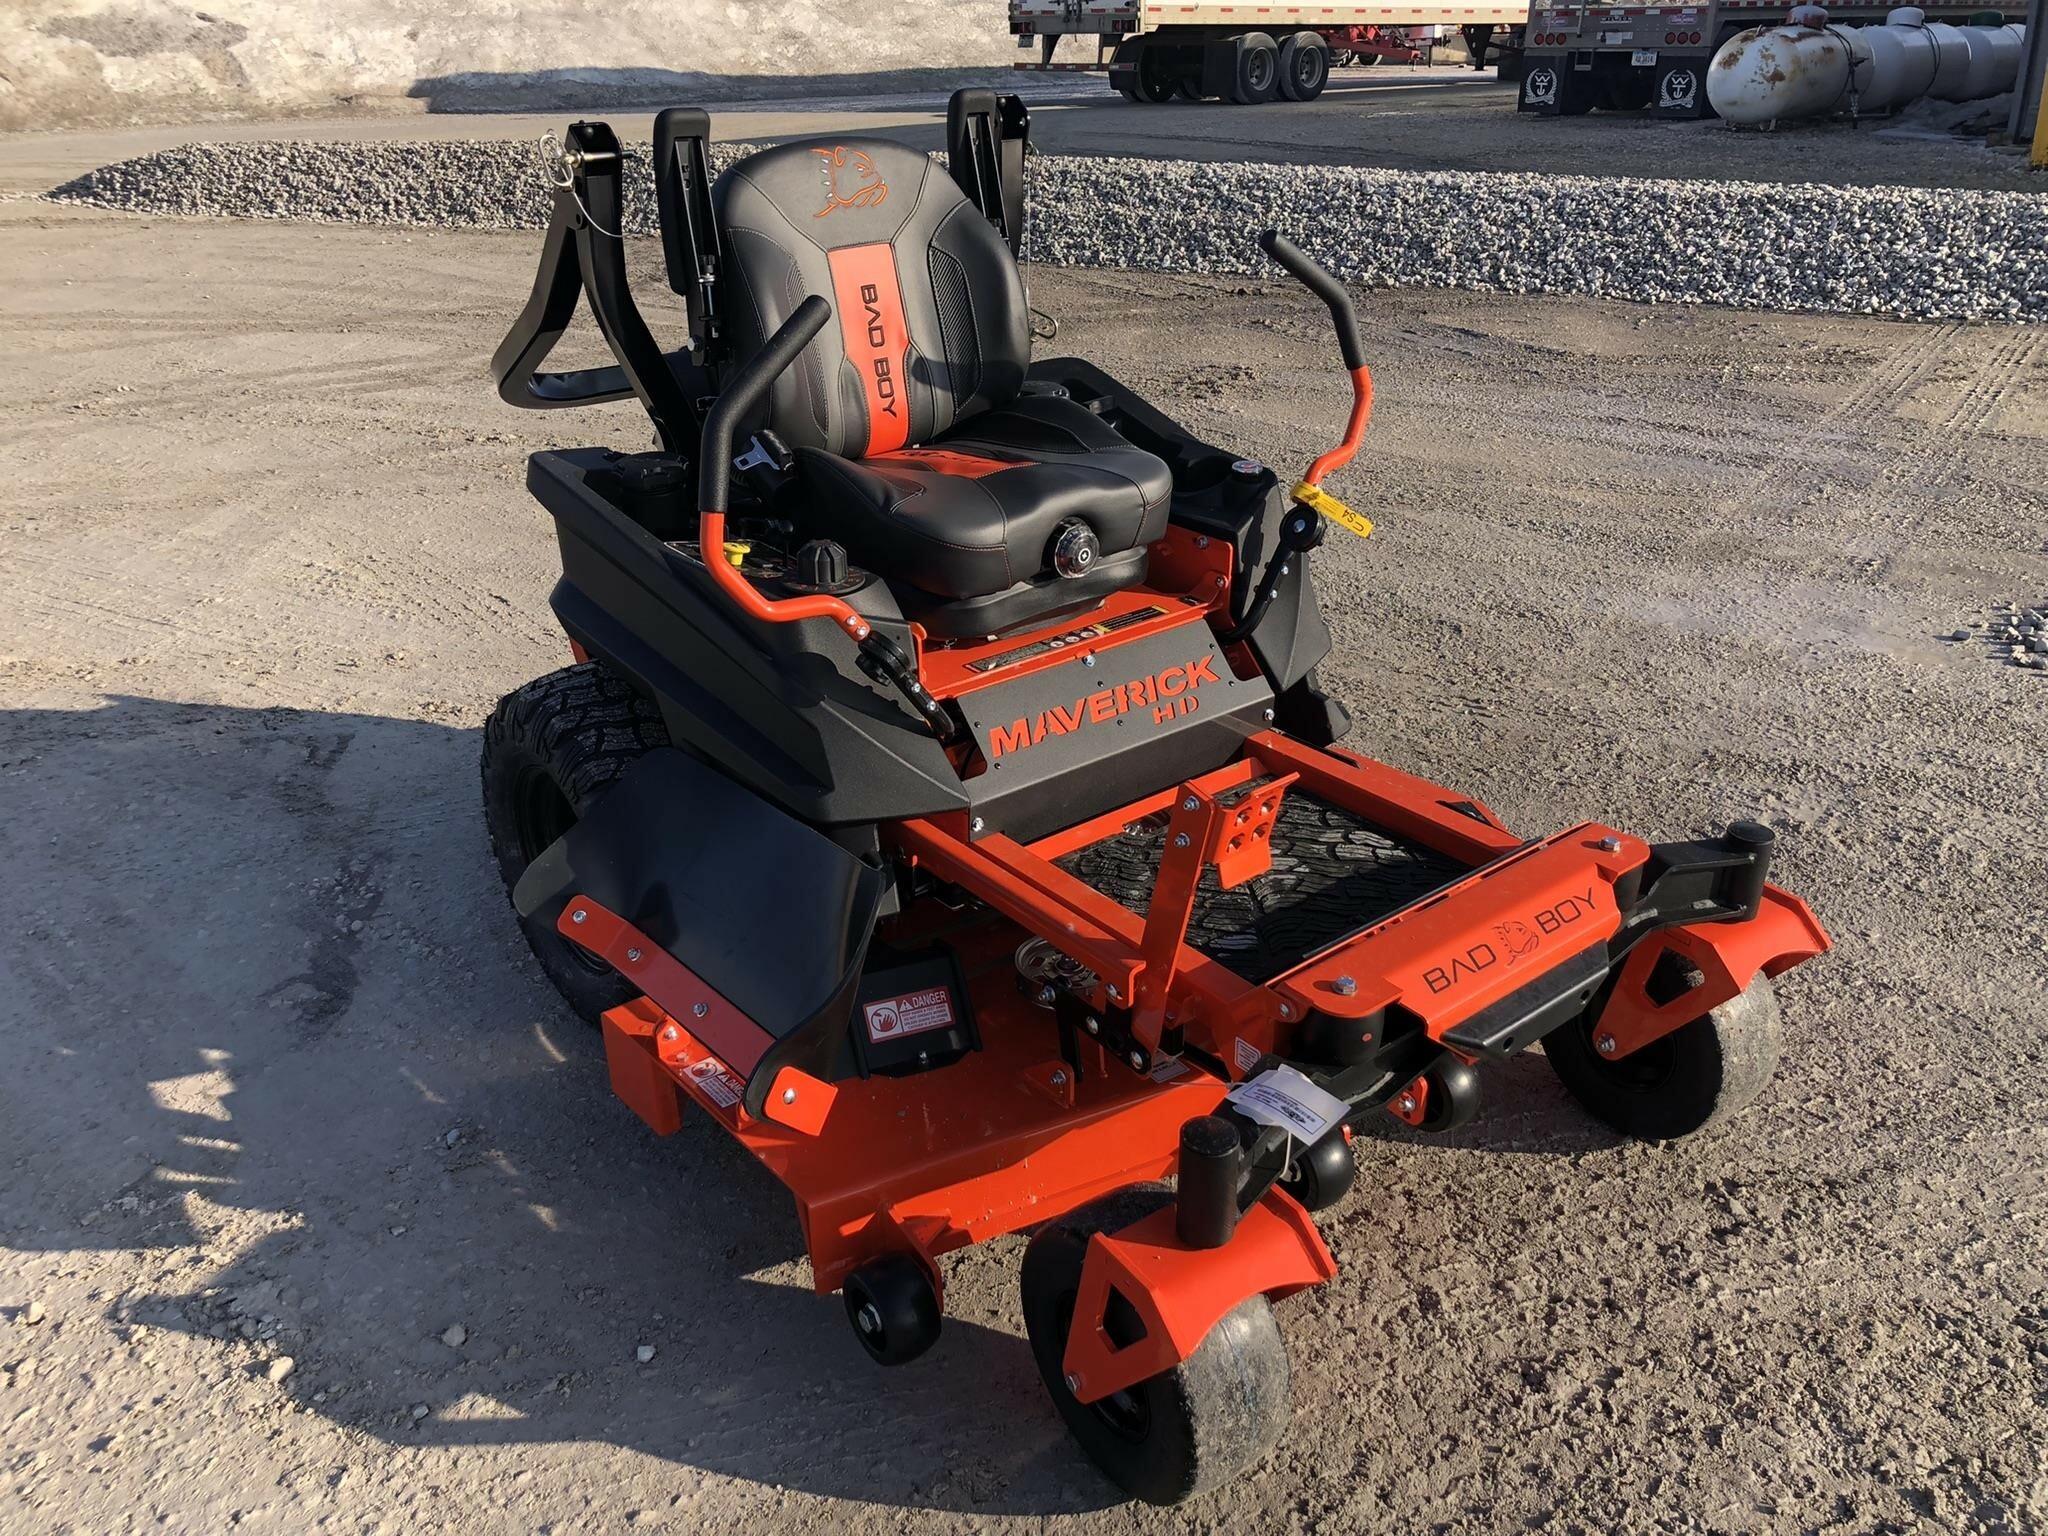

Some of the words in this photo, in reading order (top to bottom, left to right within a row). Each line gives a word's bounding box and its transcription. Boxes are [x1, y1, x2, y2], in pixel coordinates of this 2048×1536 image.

[860, 283, 885, 348] BAD
[873, 356, 897, 418] BOY
[988, 654, 1222, 758] MAVERICK
[1152, 695, 1199, 725] HD
[1422, 943, 1497, 994] BAD
[1534, 887, 1596, 935] BOY
[912, 990, 947, 1009] DANGER
